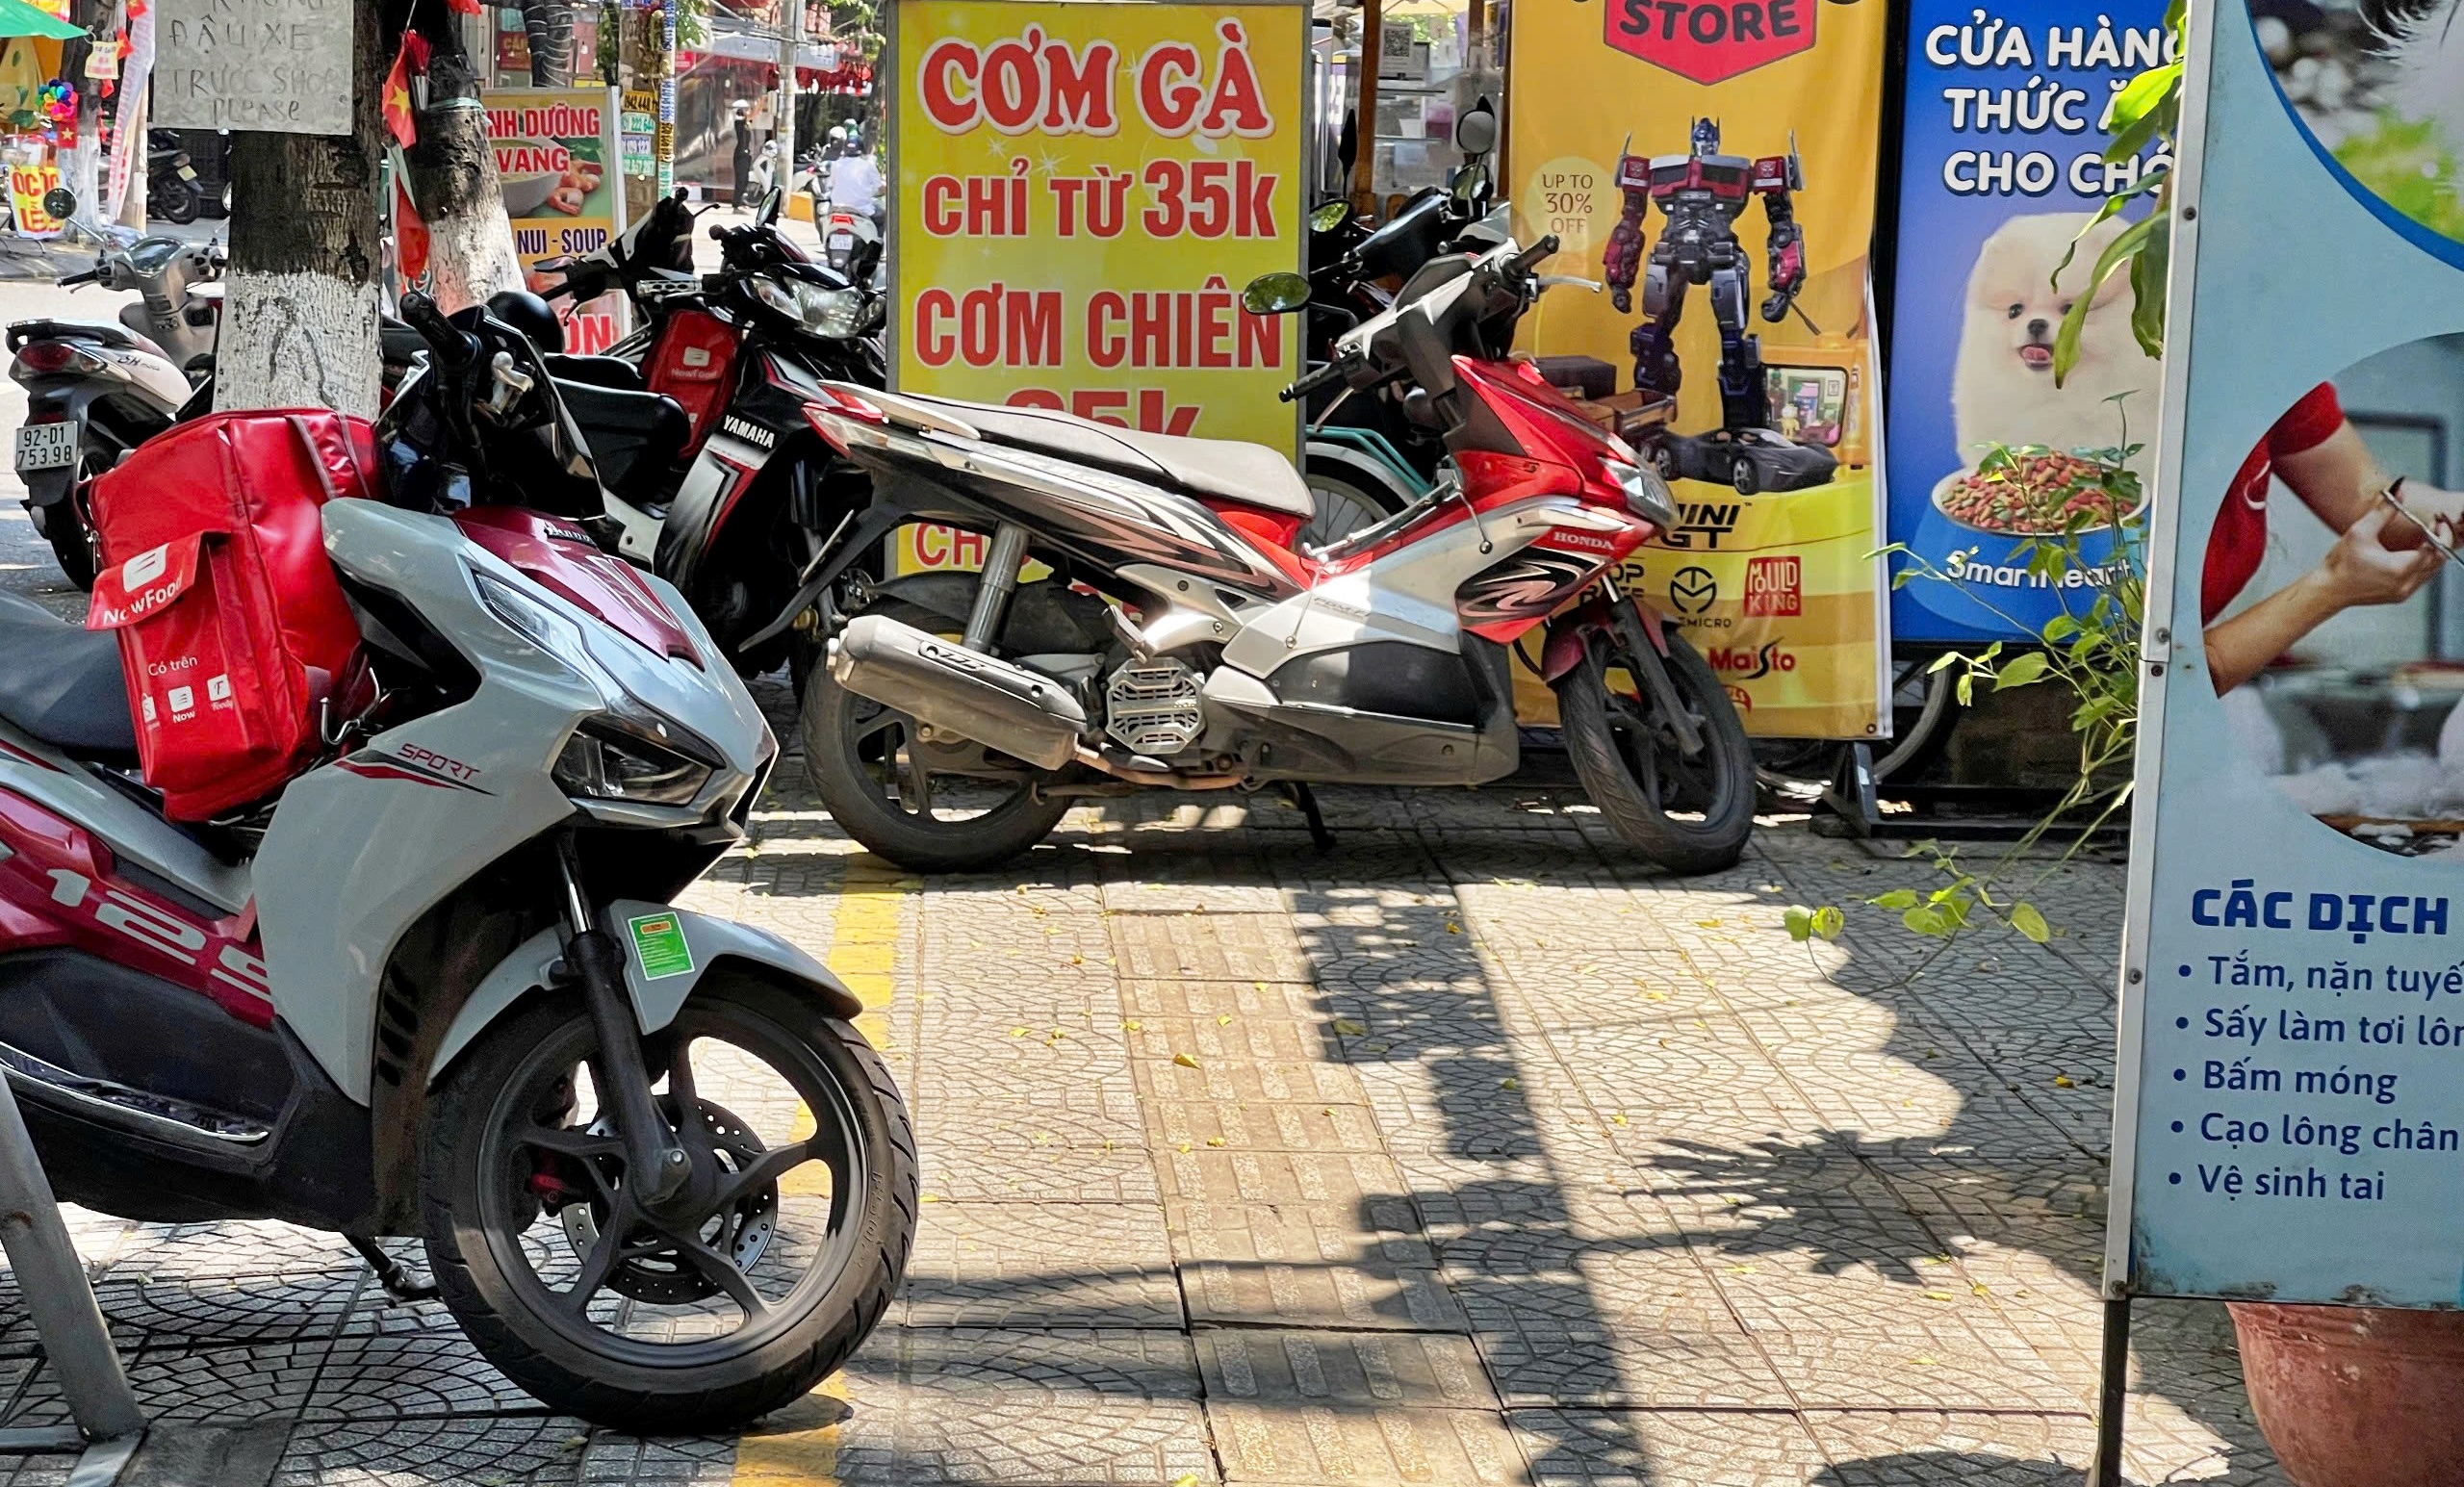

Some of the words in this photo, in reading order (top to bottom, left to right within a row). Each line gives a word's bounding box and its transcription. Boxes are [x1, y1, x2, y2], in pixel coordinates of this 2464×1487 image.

[261, 23, 313, 54] XE
[1620, 0, 1801, 44] STORE
[1925, 10, 2032, 65] CỬA
[920, 25, 1116, 133] CƠM
[1140, 22, 1270, 131] GÀ
[1943, 75, 2086, 130] THỨC
[486, 110, 518, 138] NH
[525, 103, 601, 137] DƯỠNG
[496, 148, 571, 173] VANG
[1943, 151, 2056, 192] CHO
[923, 158, 1030, 238] CHỈ
[1050, 165, 1133, 238] TỪ
[1543, 174, 1565, 189] UP
[1569, 174, 1593, 190] TO
[1546, 192, 1593, 214] 30%
[517, 230, 547, 254] NUI
[561, 228, 607, 254] SOUP
[1551, 218, 1586, 233] OFF
[915, 282, 1063, 368] CƠM
[1087, 275, 1282, 369] CHIÊN
[723, 414, 776, 449] YAMAHA
[17, 445, 72, 470] 753.98
[1553, 531, 1616, 551] HONDA
[1748, 561, 1798, 593] MOULD
[1748, 594, 1798, 613] KING
[147, 660, 167, 677] Có
[169, 655, 198, 672] trên
[172, 710, 196, 724] Now
[397, 742, 481, 781] SPORT
[2308, 893, 2450, 944] DỊCH
[2307, 961, 2374, 997] nặn
[2204, 1004, 2268, 1047] Sấy
[2279, 1009, 2346, 1042] làm
[2358, 1014, 2404, 1045] tơi
[2203, 1056, 2281, 1092] Bấm
[2295, 1064, 2398, 1105] móng
[2200, 1113, 2270, 1150] Cạo
[2282, 1114, 2362, 1155] lông
[2373, 1118, 2459, 1151] chân
[2197, 1164, 2244, 1202] Vệ
[2254, 1167, 2327, 1198] sinh
[2340, 1171, 2385, 1201] tai
